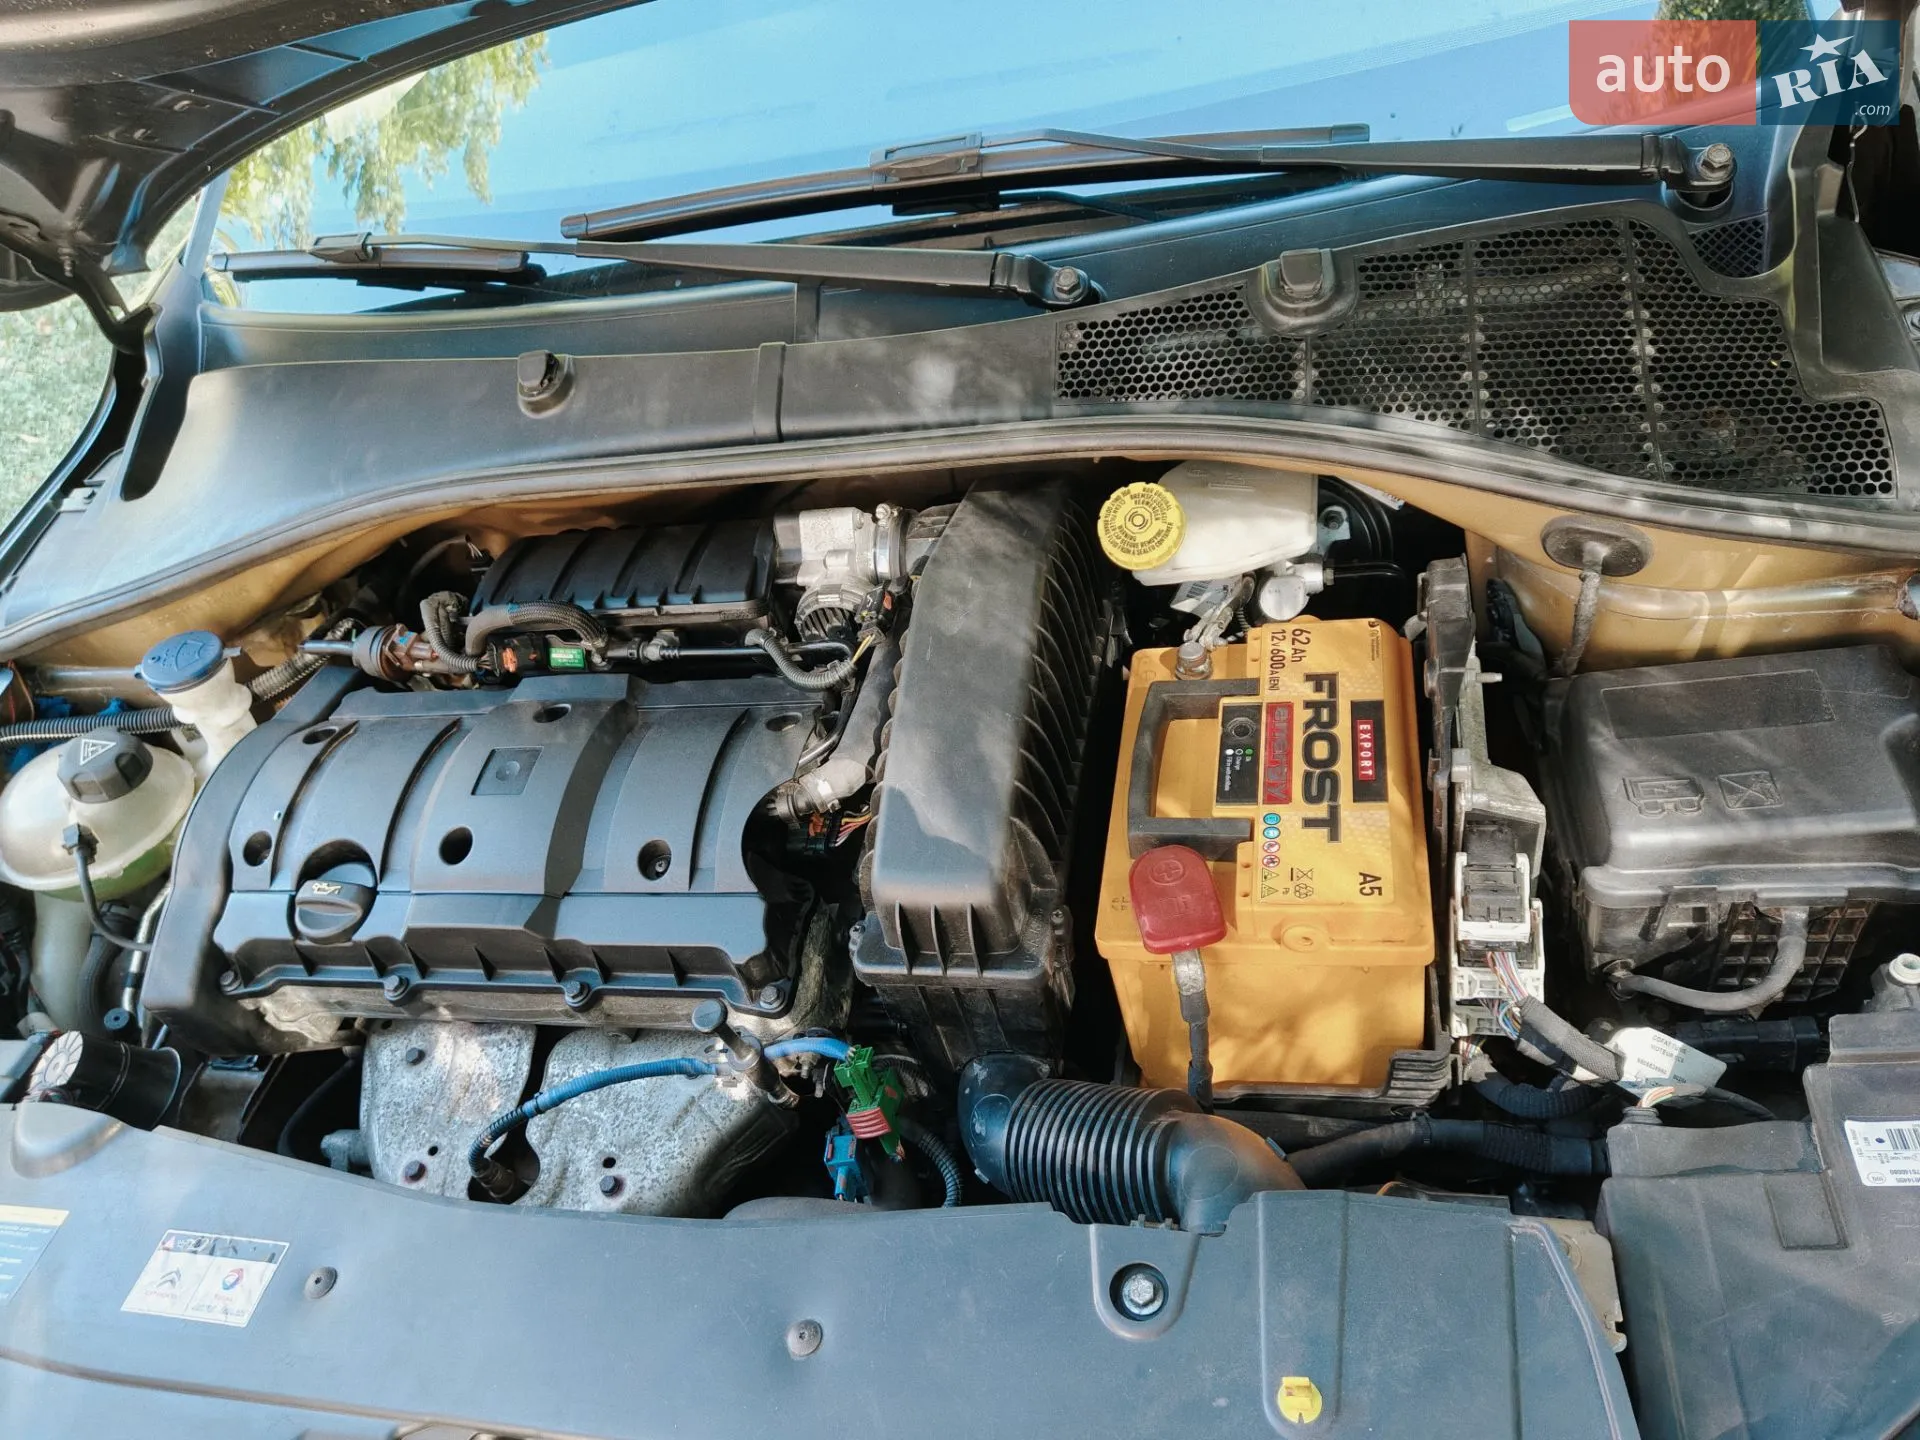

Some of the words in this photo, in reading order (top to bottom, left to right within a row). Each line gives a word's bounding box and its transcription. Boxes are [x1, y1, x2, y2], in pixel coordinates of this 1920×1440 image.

[1301, 671, 1342, 843] FROST
[1359, 724, 1373, 776] EXPORT
[1358, 871, 1383, 896] A5
